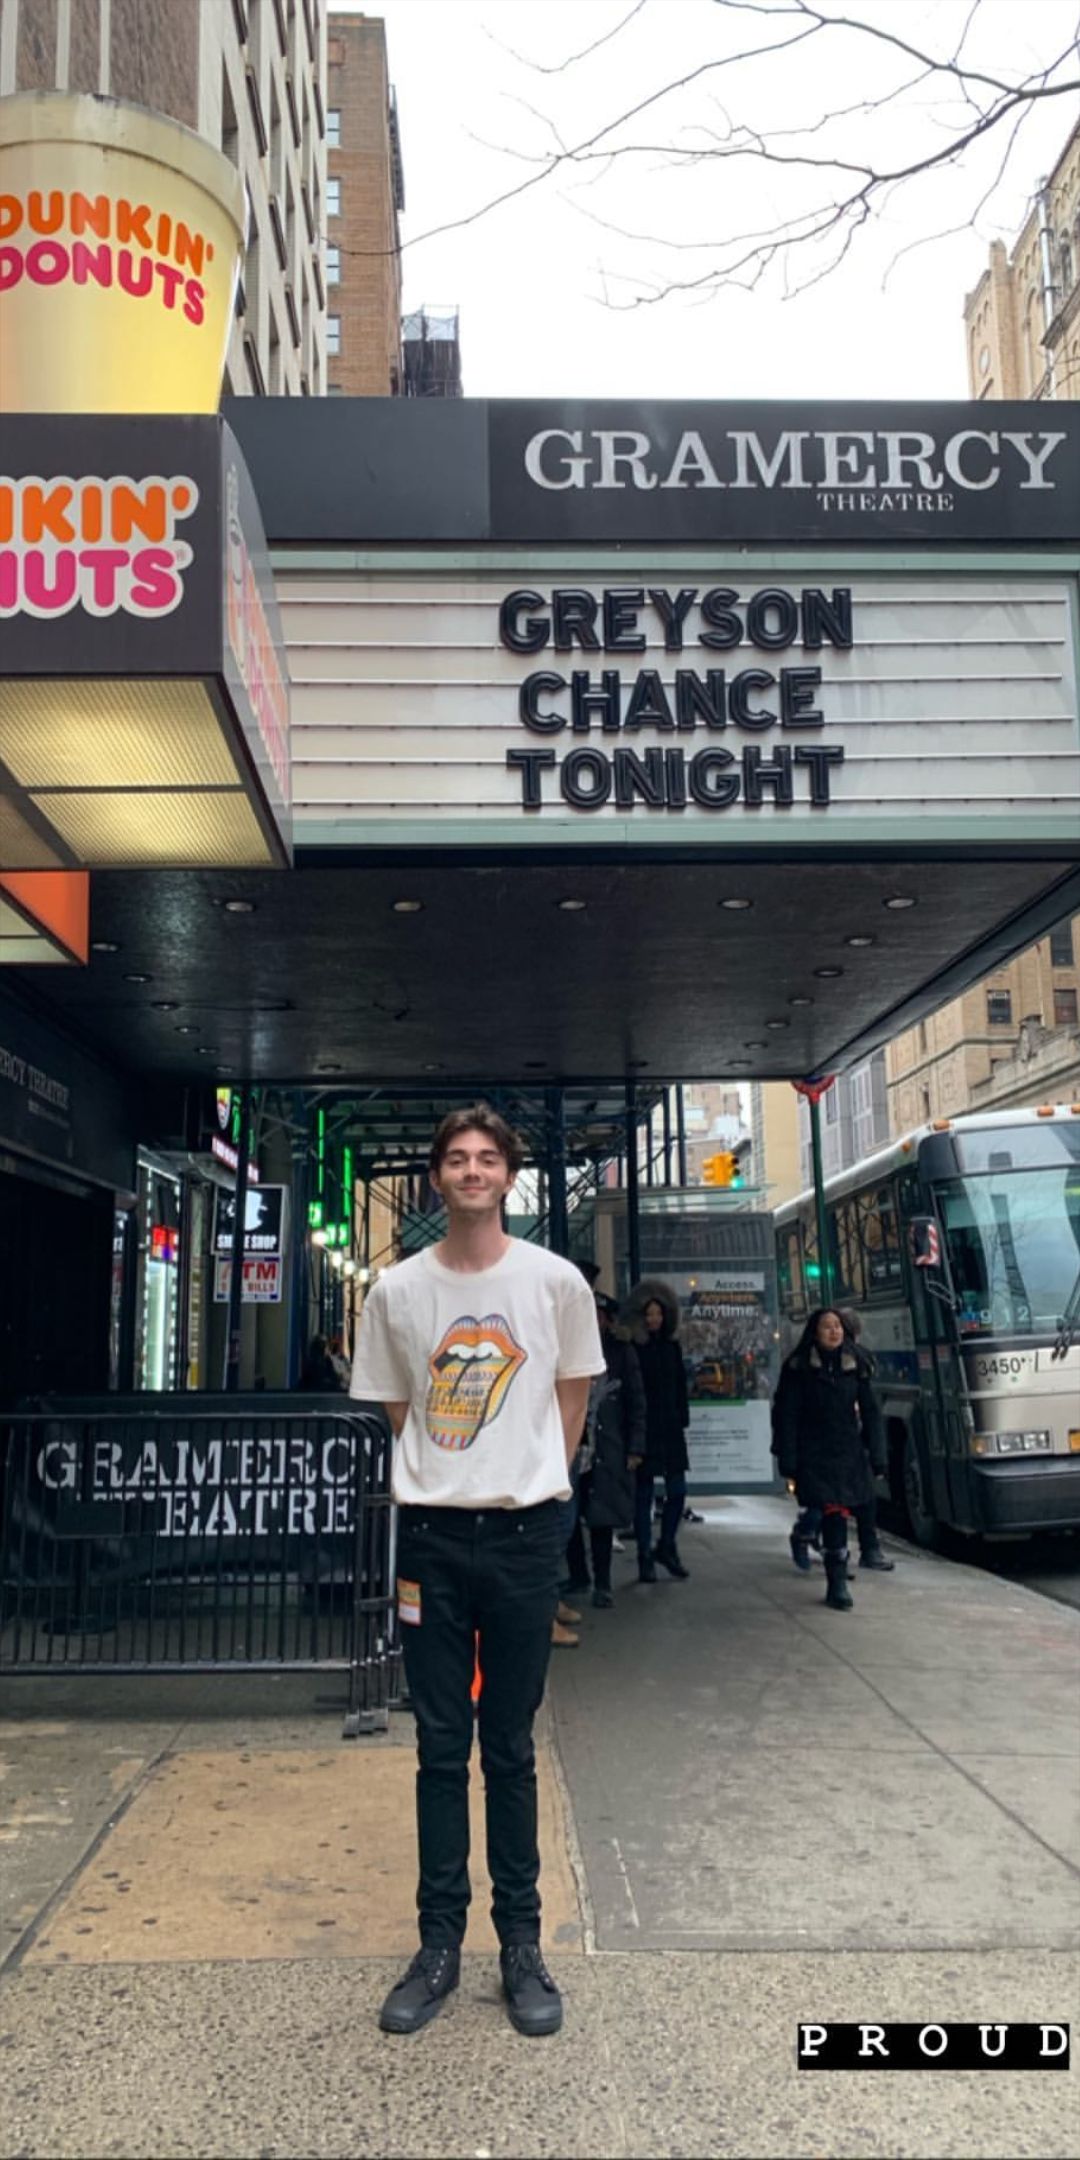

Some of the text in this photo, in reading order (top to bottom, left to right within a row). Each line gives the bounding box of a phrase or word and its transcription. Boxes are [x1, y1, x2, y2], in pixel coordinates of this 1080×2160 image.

[524, 429, 1067, 491] GRAMERCY
[0, 484, 192, 544] KIN'
[816, 493, 955, 513] THEATRE
[500, 588, 854, 653] GREYSON
[518, 667, 826, 733] CHANCE
[506, 745, 845, 810] TONIGHT
[217, 1234, 277, 1250] SME SHOP
[76, 1488, 355, 1537] EATRE
